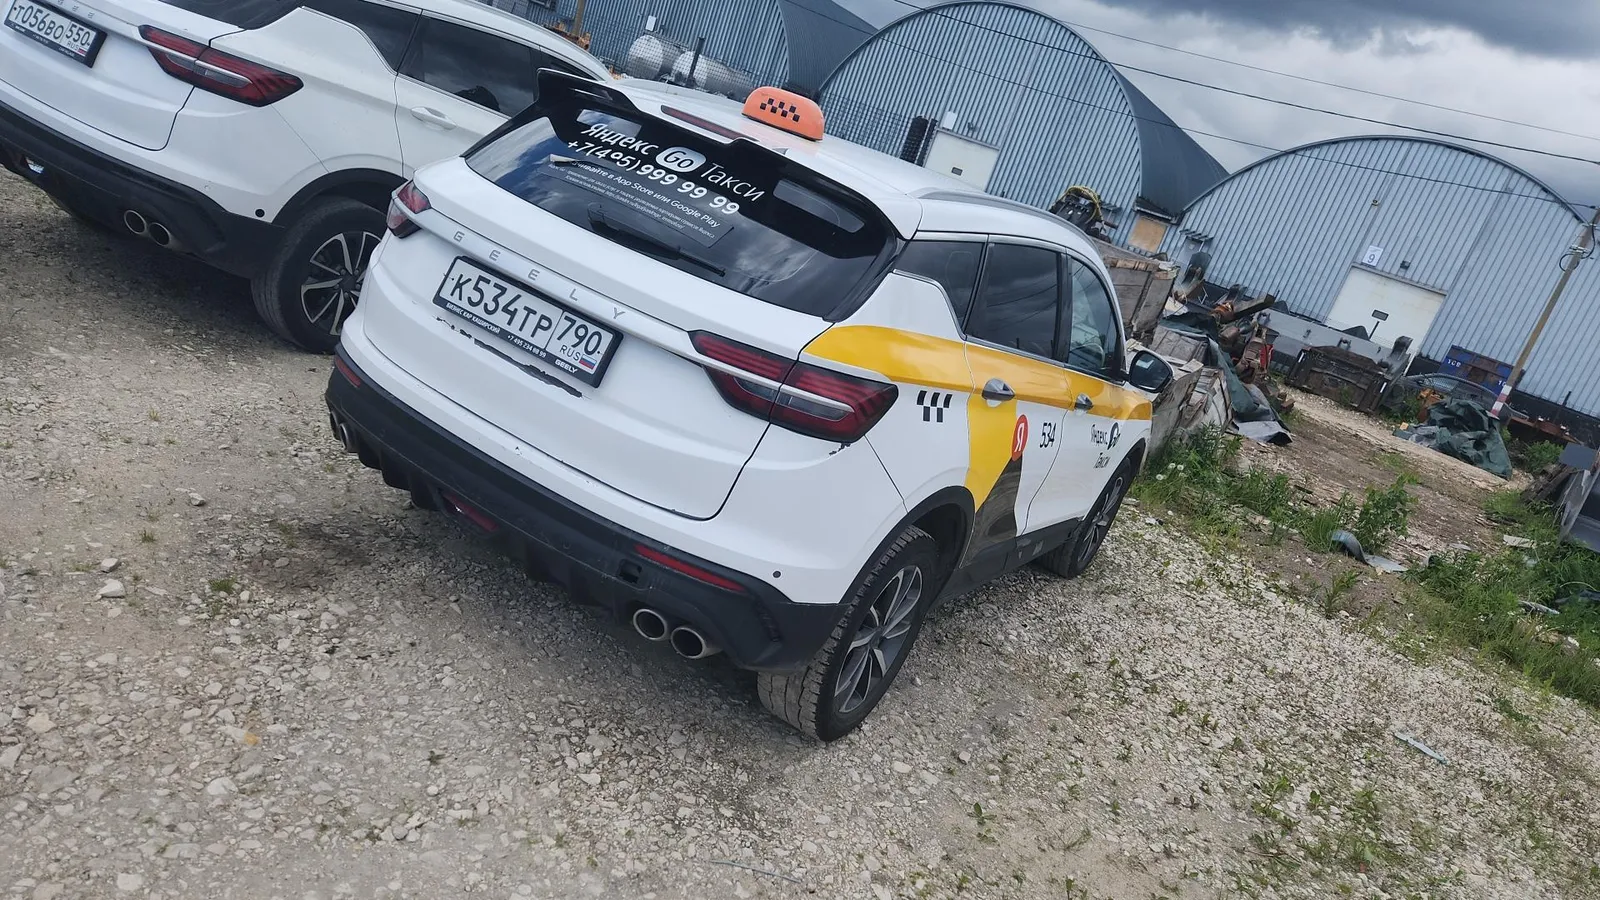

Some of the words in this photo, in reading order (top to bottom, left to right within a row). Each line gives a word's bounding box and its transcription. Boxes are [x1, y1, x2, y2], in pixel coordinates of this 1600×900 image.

[65, 23, 91, 46] 550
[66, 41, 79, 51] RUS
[580, 123, 659, 155] Яндекс
[663, 150, 694, 169] Go
[700, 162, 765, 202] Такси
[613, 176, 632, 187] App
[631, 182, 654, 196] Store
[653, 193, 671, 203] или
[670, 200, 701, 218] Google
[700, 214, 721, 228] Play
[677, 181, 708, 198] 99
[708, 196, 740, 214] 99
[453, 230, 626, 320] GEELY
[450, 273, 553, 338] К534ТР
[556, 315, 602, 355] 790
[554, 358, 578, 374] GEELY
[560, 344, 581, 361] RUS
[1014, 422, 1025, 453] Я
[1040, 422, 1057, 448] 534
